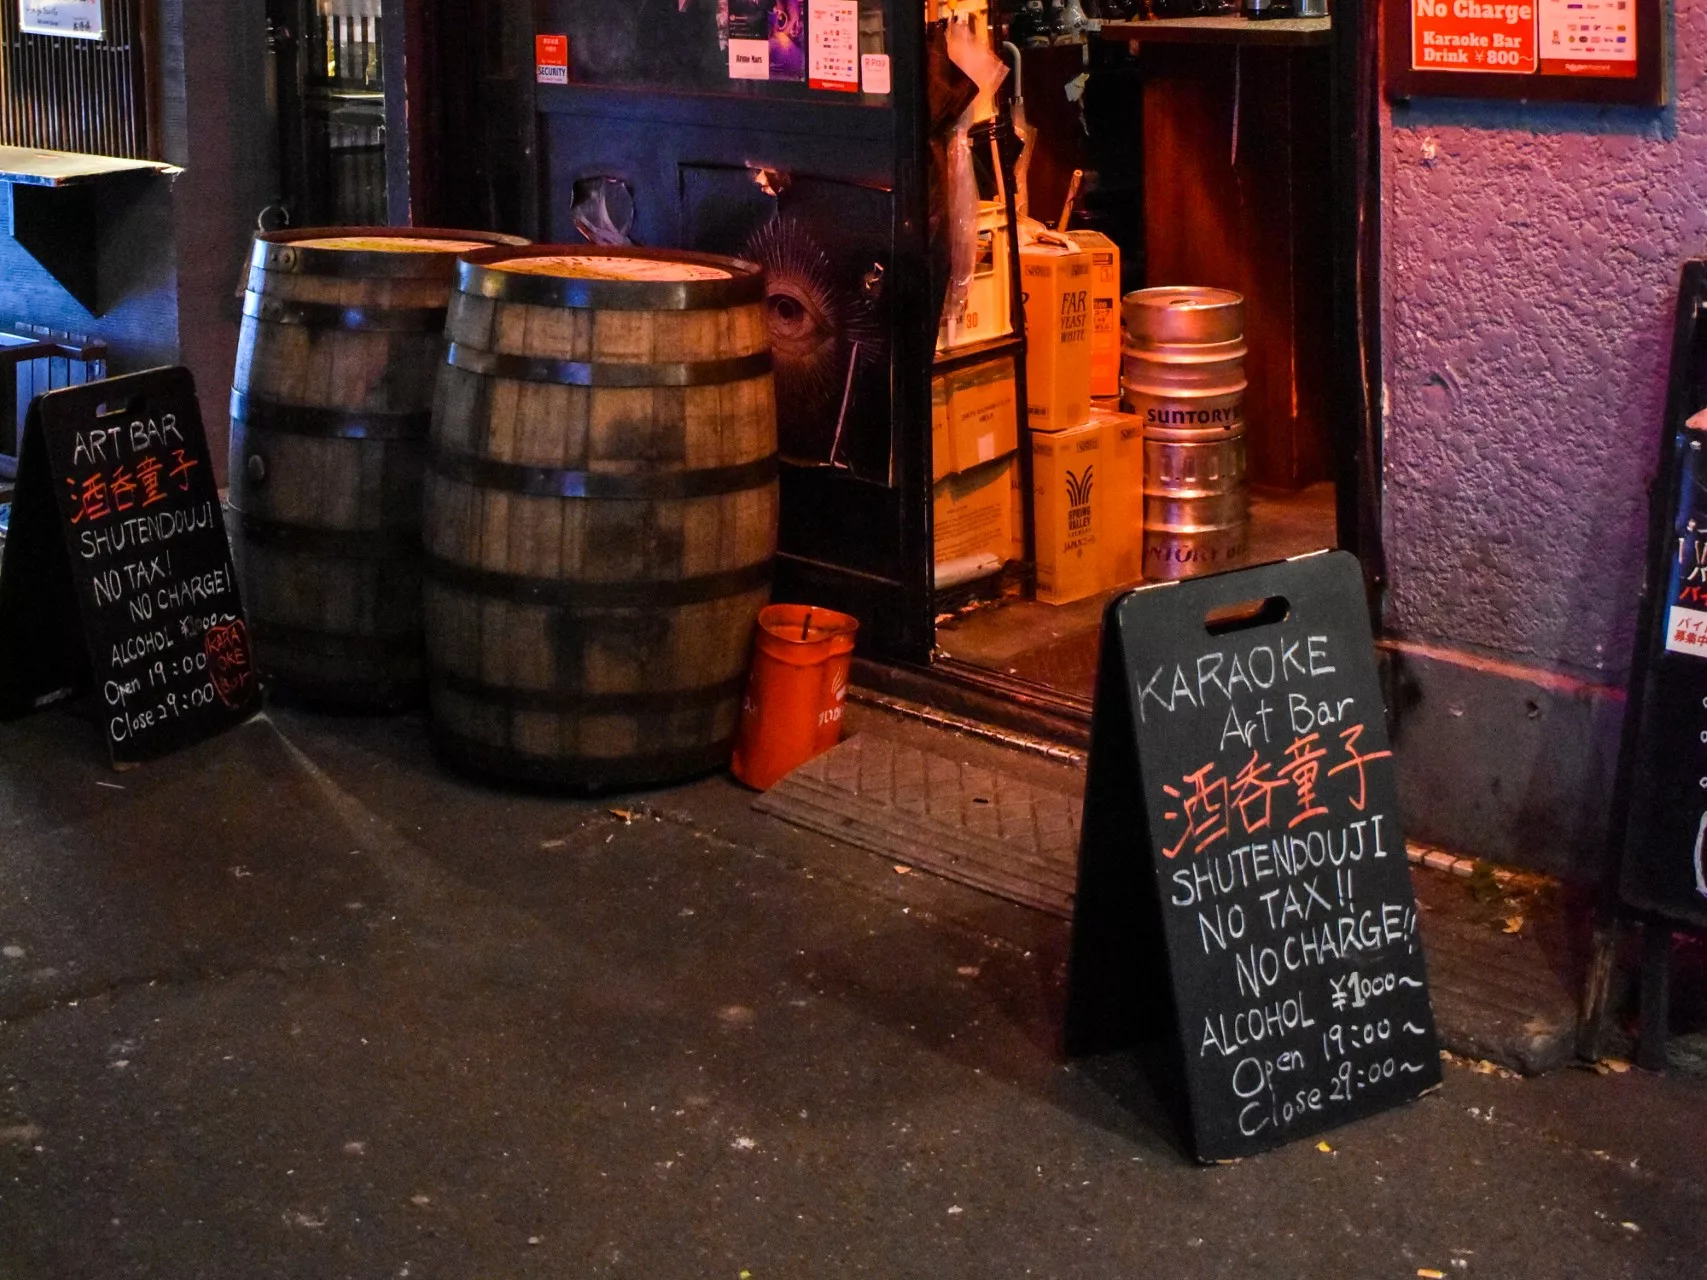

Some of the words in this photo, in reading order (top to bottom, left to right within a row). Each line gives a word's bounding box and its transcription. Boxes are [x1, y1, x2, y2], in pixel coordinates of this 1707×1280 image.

[1423, 31, 1488, 47] Karaoke
[1492, 33, 1522, 48] Bar
[1423, 48, 1469, 63] Drink
[537, 66, 566, 77] SECURITY
[1060, 315, 1086, 329] YEAST
[1061, 290, 1087, 314] FAR
[1060, 329, 1085, 343] WHITE
[74, 427, 121, 466] ART
[130, 413, 184, 452] BAR
[66, 449, 198, 524] 酒呑童子
[81, 501, 214, 558] SHUTENDOUJI
[1068, 516, 1091, 531] VALLEY
[93, 569, 121, 606] NO
[124, 550, 172, 589] TAX!
[129, 593, 152, 622] NO
[157, 563, 231, 609] CHARGE!
[112, 628, 174, 668] ALCOHOL
[104, 678, 141, 706] Open
[149, 652, 206, 686] 19:00
[1136, 636, 1336, 722] KARAOKE
[111, 711, 155, 741] Close
[159, 683, 214, 717] 29:00
[1220, 699, 1273, 751] Art
[1289, 693, 1354, 734] Bar
[1162, 724, 1393, 859] 酒呑童子
[1172, 814, 1387, 906] SHUTENDOUJI
[1198, 904, 1246, 954] NO
[1235, 944, 1279, 998] NO
[1284, 902, 1417, 970] CHARGE!!
[1200, 991, 1315, 1057] ALCOHOL
[1232, 1050, 1305, 1097] Open
[1239, 1088, 1323, 1136] Close
